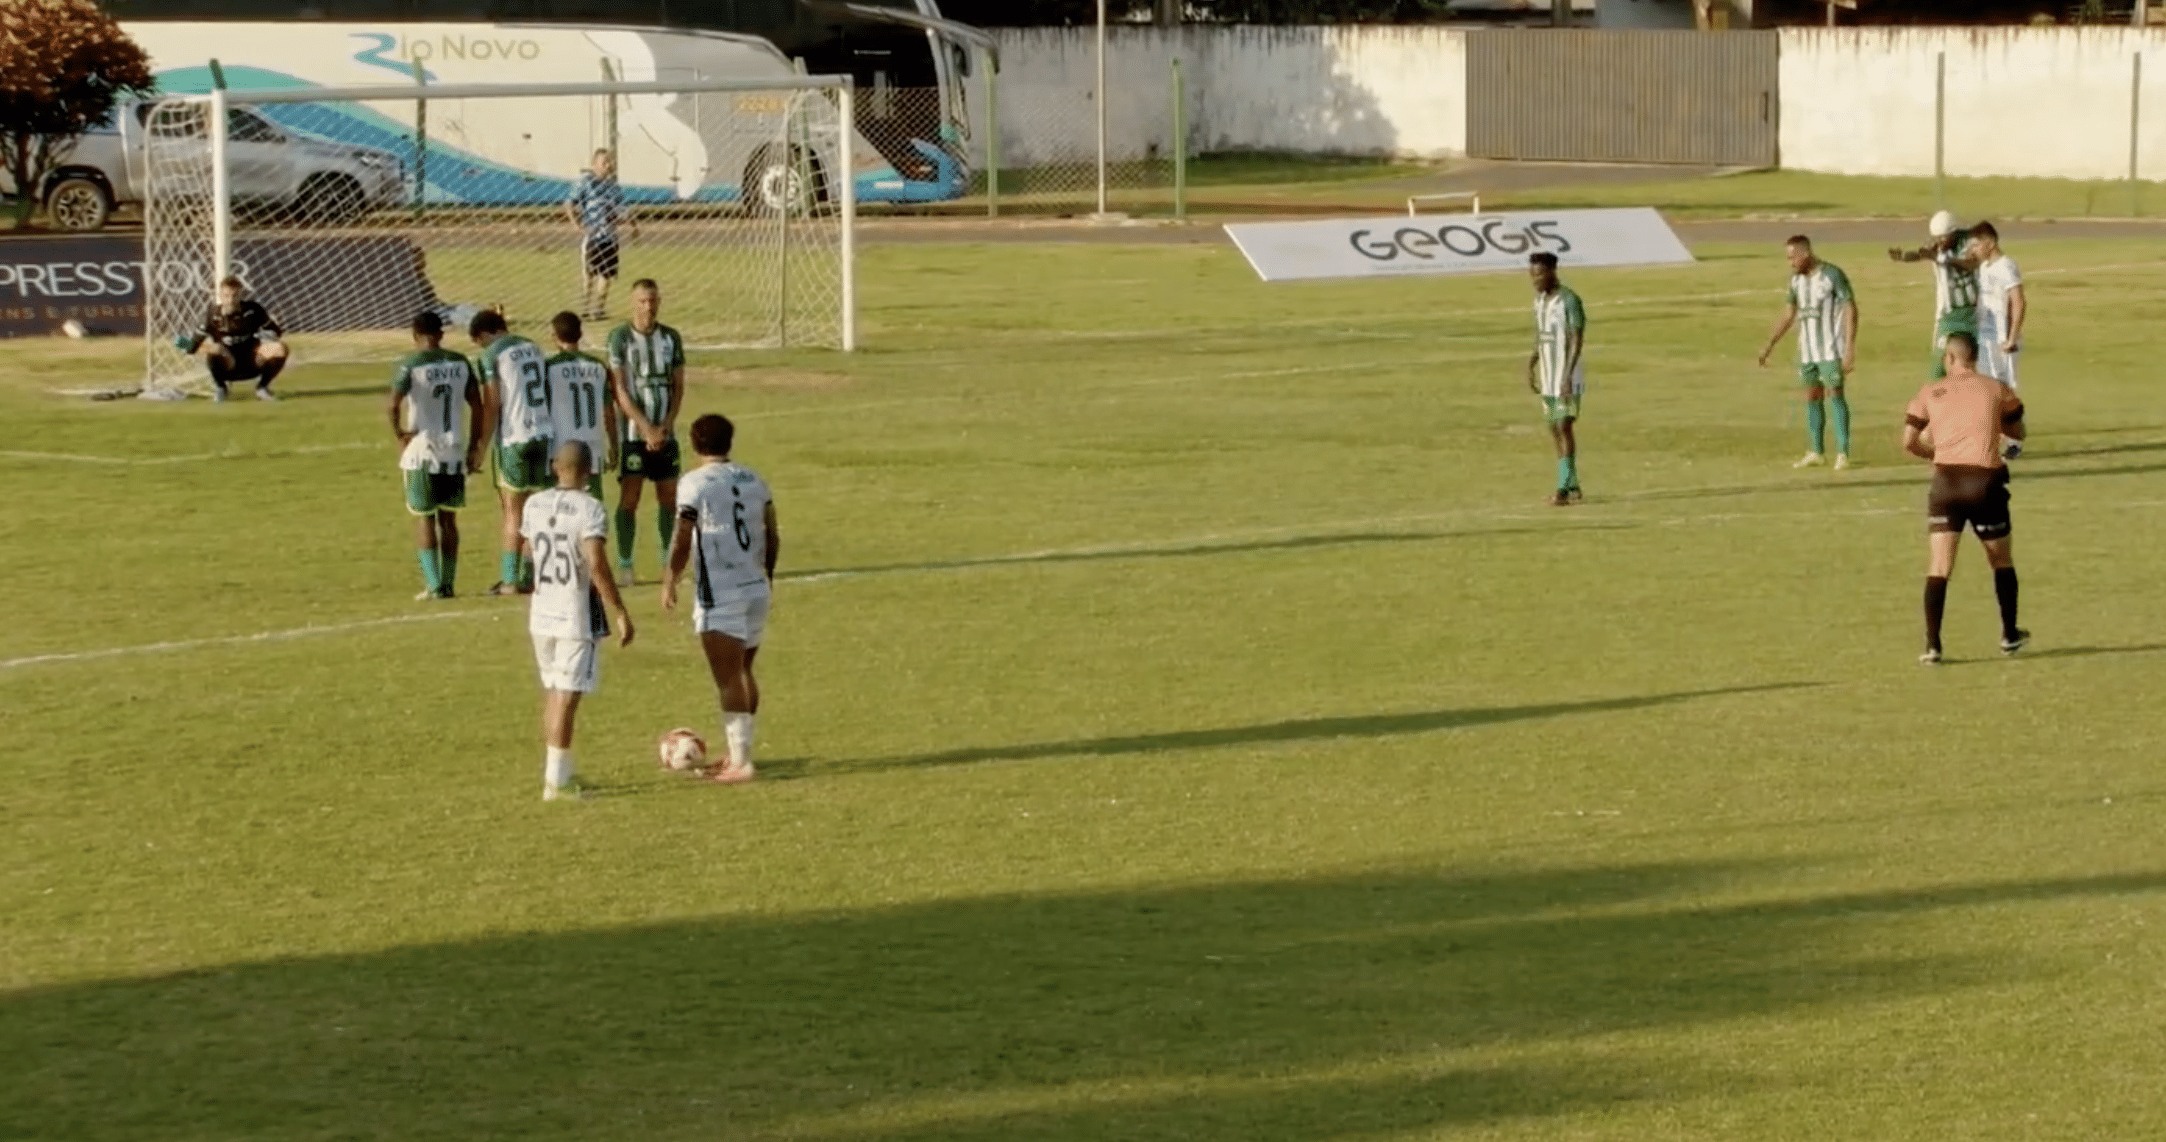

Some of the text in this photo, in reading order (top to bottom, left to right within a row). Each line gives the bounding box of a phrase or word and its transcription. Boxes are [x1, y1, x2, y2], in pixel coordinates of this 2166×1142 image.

[432, 383, 453, 432] 7
[569, 382, 597, 429] 11
[732, 501, 751, 552] 6
[534, 532, 571, 586] 25
